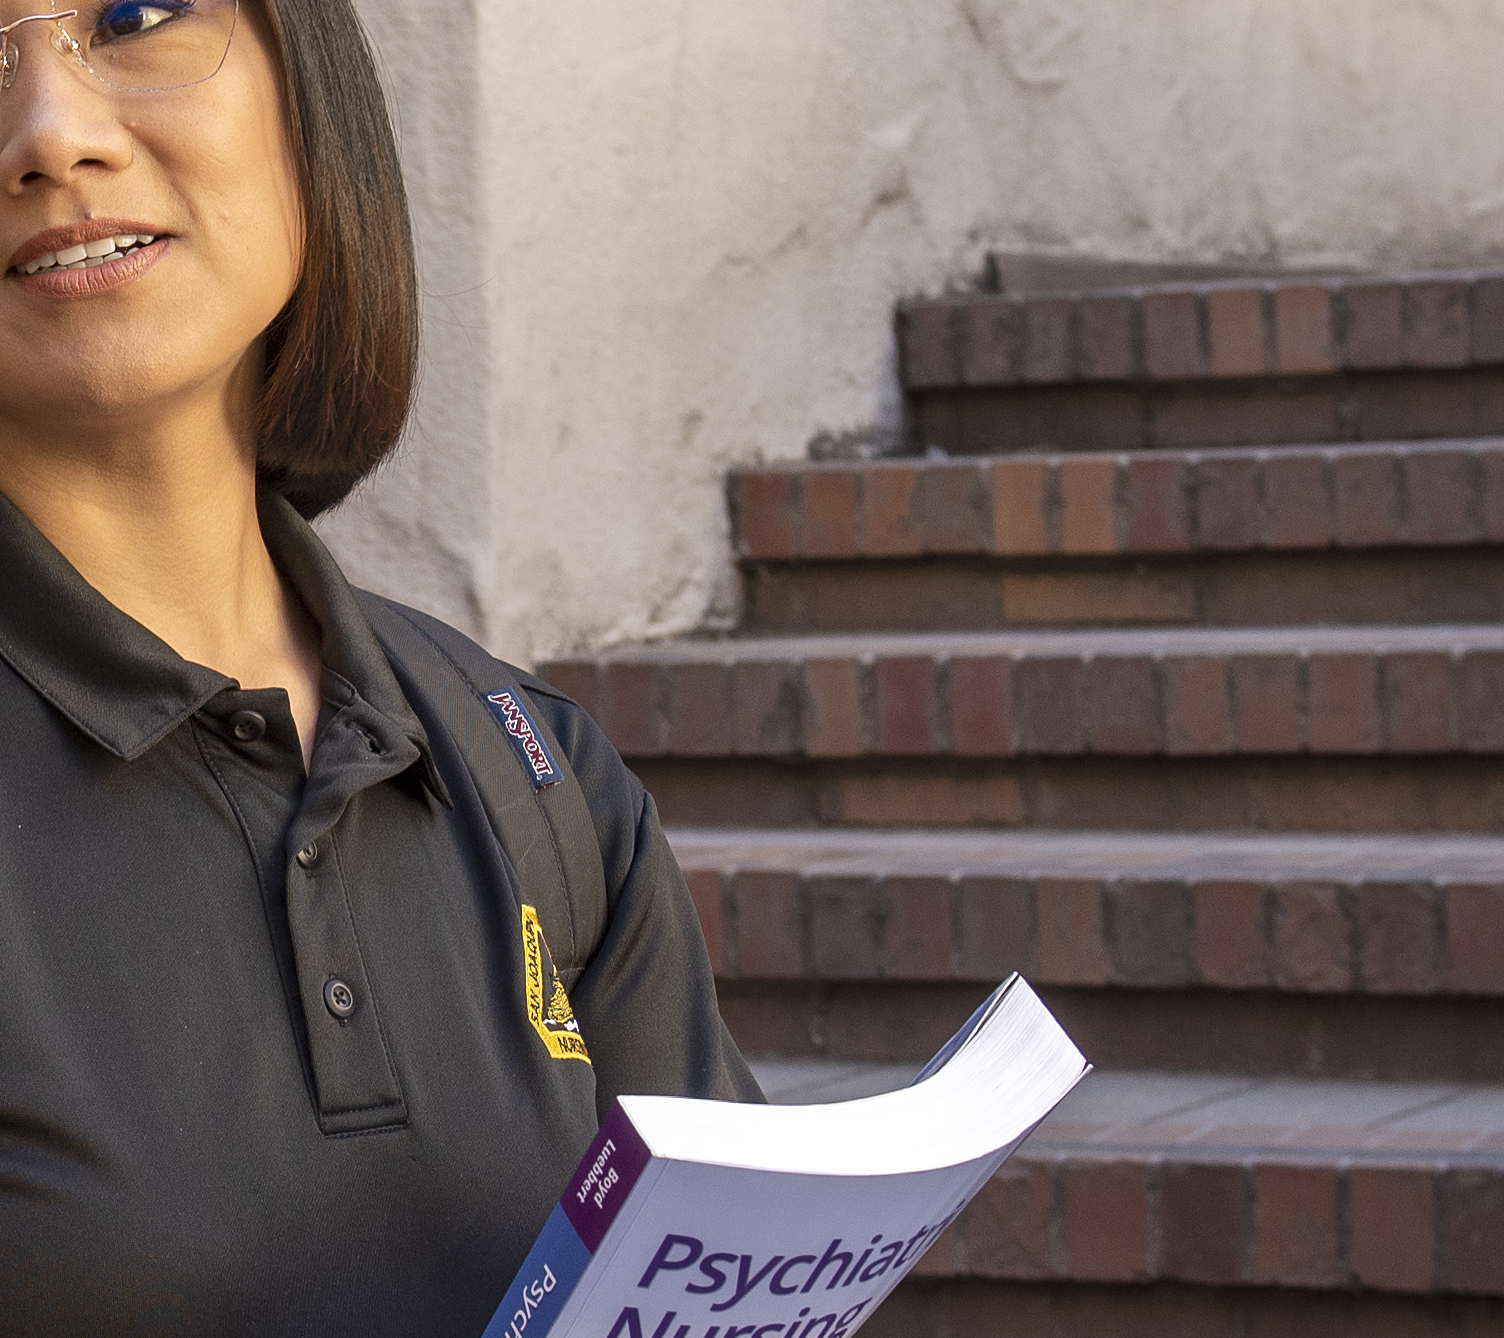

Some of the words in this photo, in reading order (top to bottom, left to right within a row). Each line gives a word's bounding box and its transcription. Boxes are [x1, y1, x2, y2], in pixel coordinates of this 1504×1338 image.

[525, 914, 539, 987] JOAQUIN
[529, 989, 540, 1025] SAN
[576, 1138, 617, 1204] Luebbert
[593, 1167, 619, 1210] Boyd
[637, 1198, 966, 1312] Psychiatri
